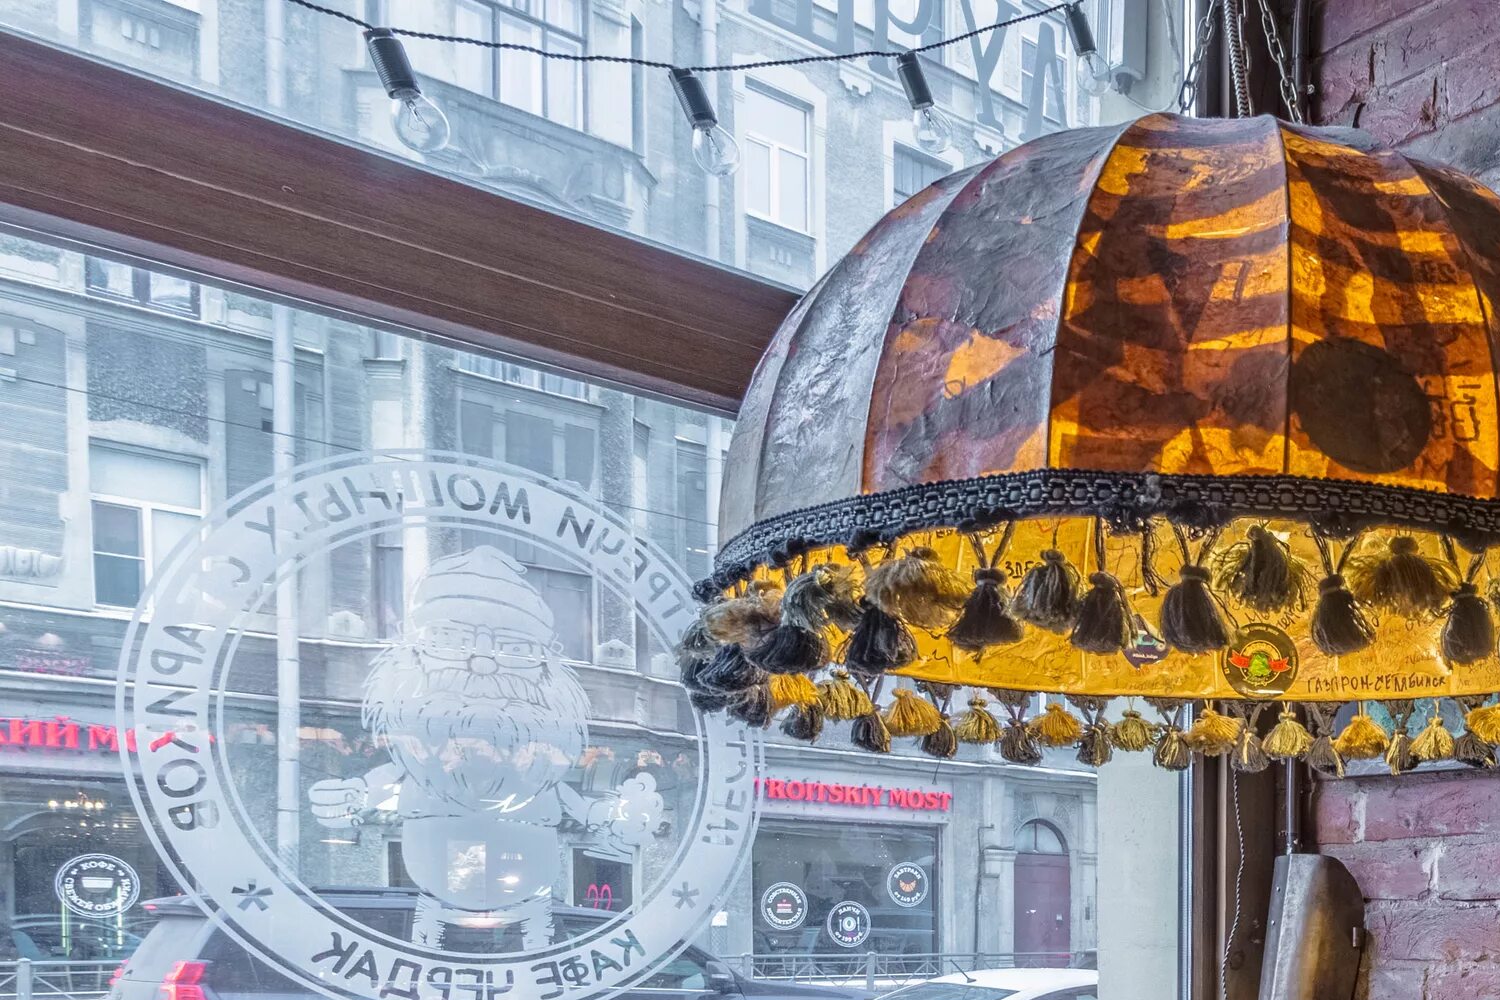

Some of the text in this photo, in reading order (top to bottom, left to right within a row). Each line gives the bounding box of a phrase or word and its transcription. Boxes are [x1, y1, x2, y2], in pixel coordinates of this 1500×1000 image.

[888, 787, 953, 812] MOST
[80, 861, 116, 871] КОФЕ
[893, 867, 922, 881] ЗАВТРАКИ
[64, 877, 93, 911] СВЕЖЕЙ
[767, 887, 802, 905] СОБСТВЕННАЯ
[766, 907, 803, 926] КОНДИТЕРСКАЯ
[837, 906, 861, 916] ЛАНЧИ
